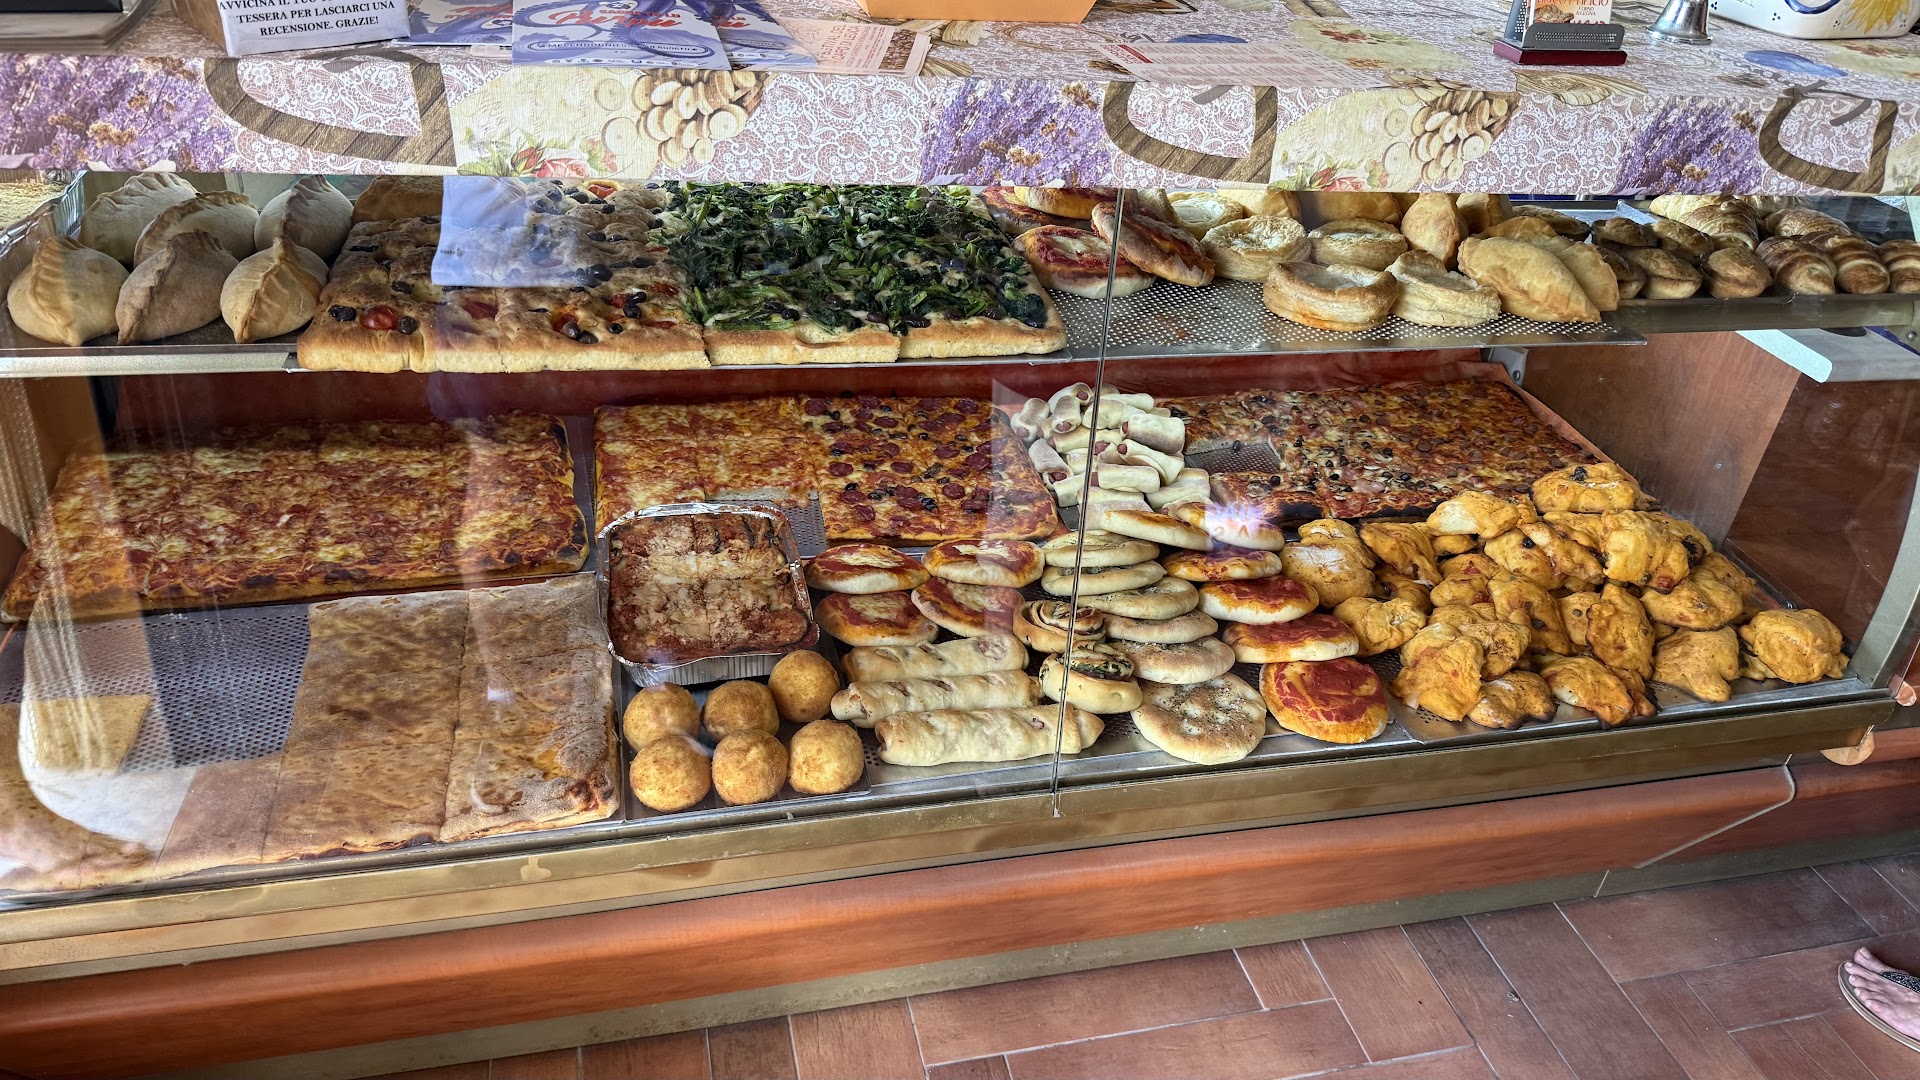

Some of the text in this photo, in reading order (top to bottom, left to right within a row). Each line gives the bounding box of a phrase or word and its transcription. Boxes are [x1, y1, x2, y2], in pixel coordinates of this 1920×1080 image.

[236, 1, 396, 23] TESSERA PER LASCIARCI UNA
[260, 16, 380, 36] RECENSIONE. GRAZIE!
